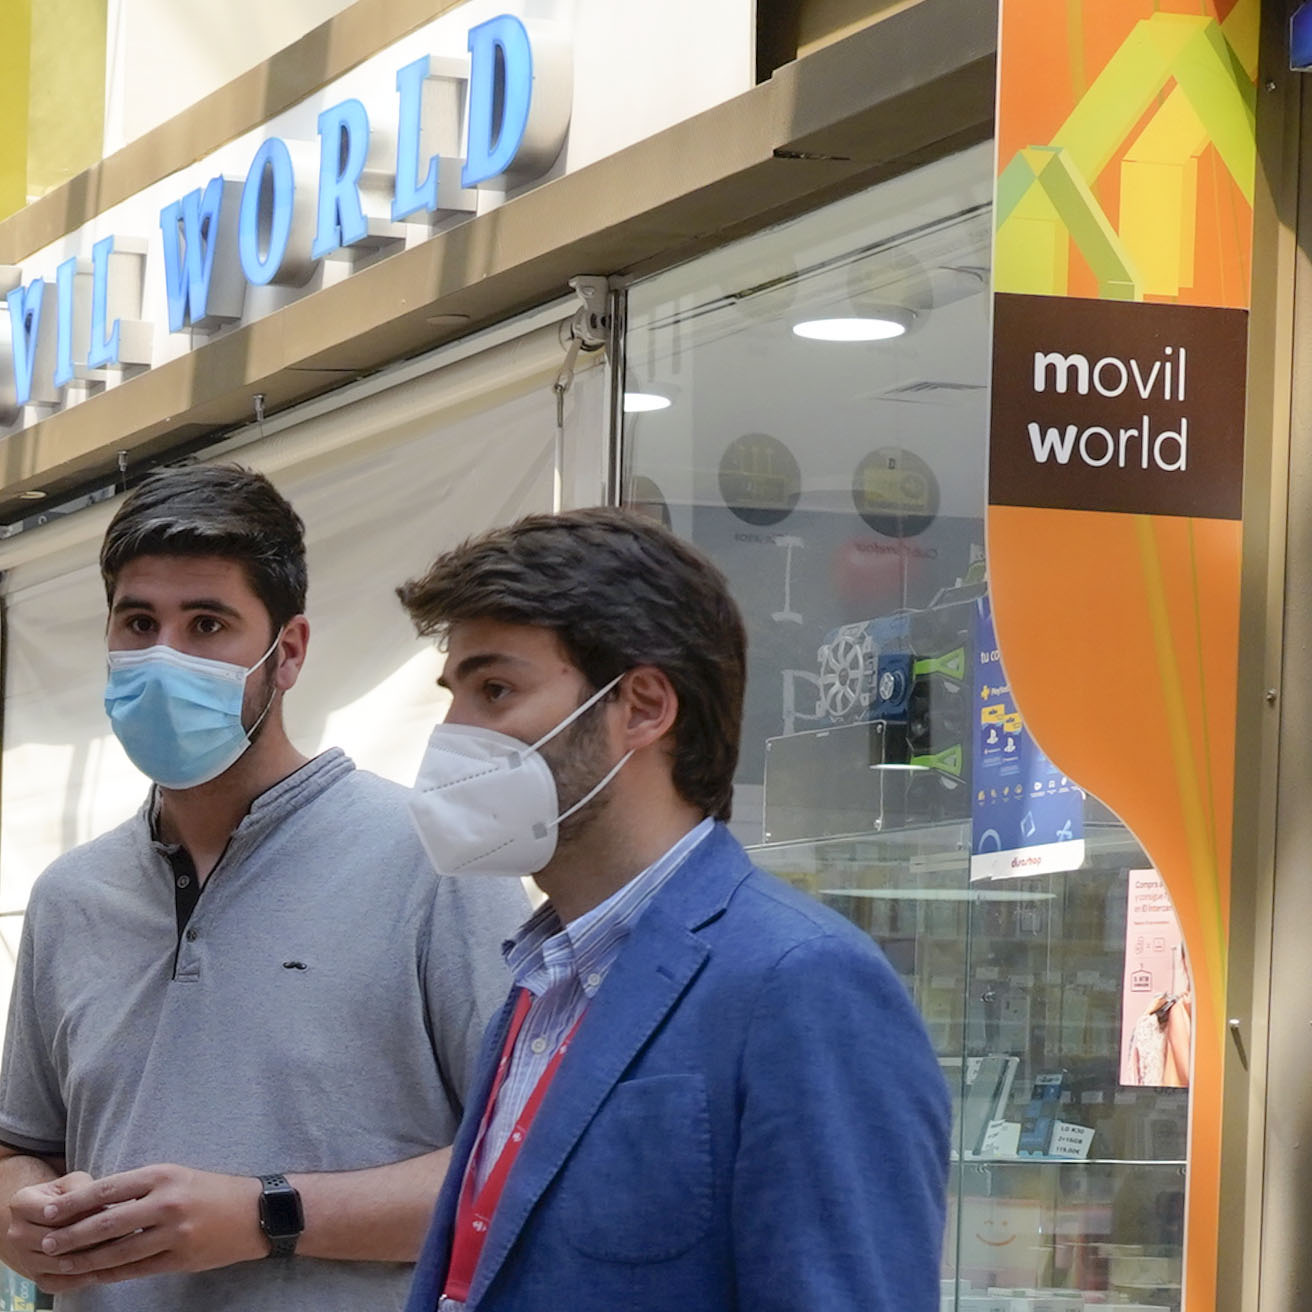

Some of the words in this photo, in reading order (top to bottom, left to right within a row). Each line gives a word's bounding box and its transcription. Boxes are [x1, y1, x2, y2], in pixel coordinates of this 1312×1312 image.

[159, 13, 535, 335] WORLD
[1032, 346, 1187, 401] movil
[1026, 415, 1188, 472] world
